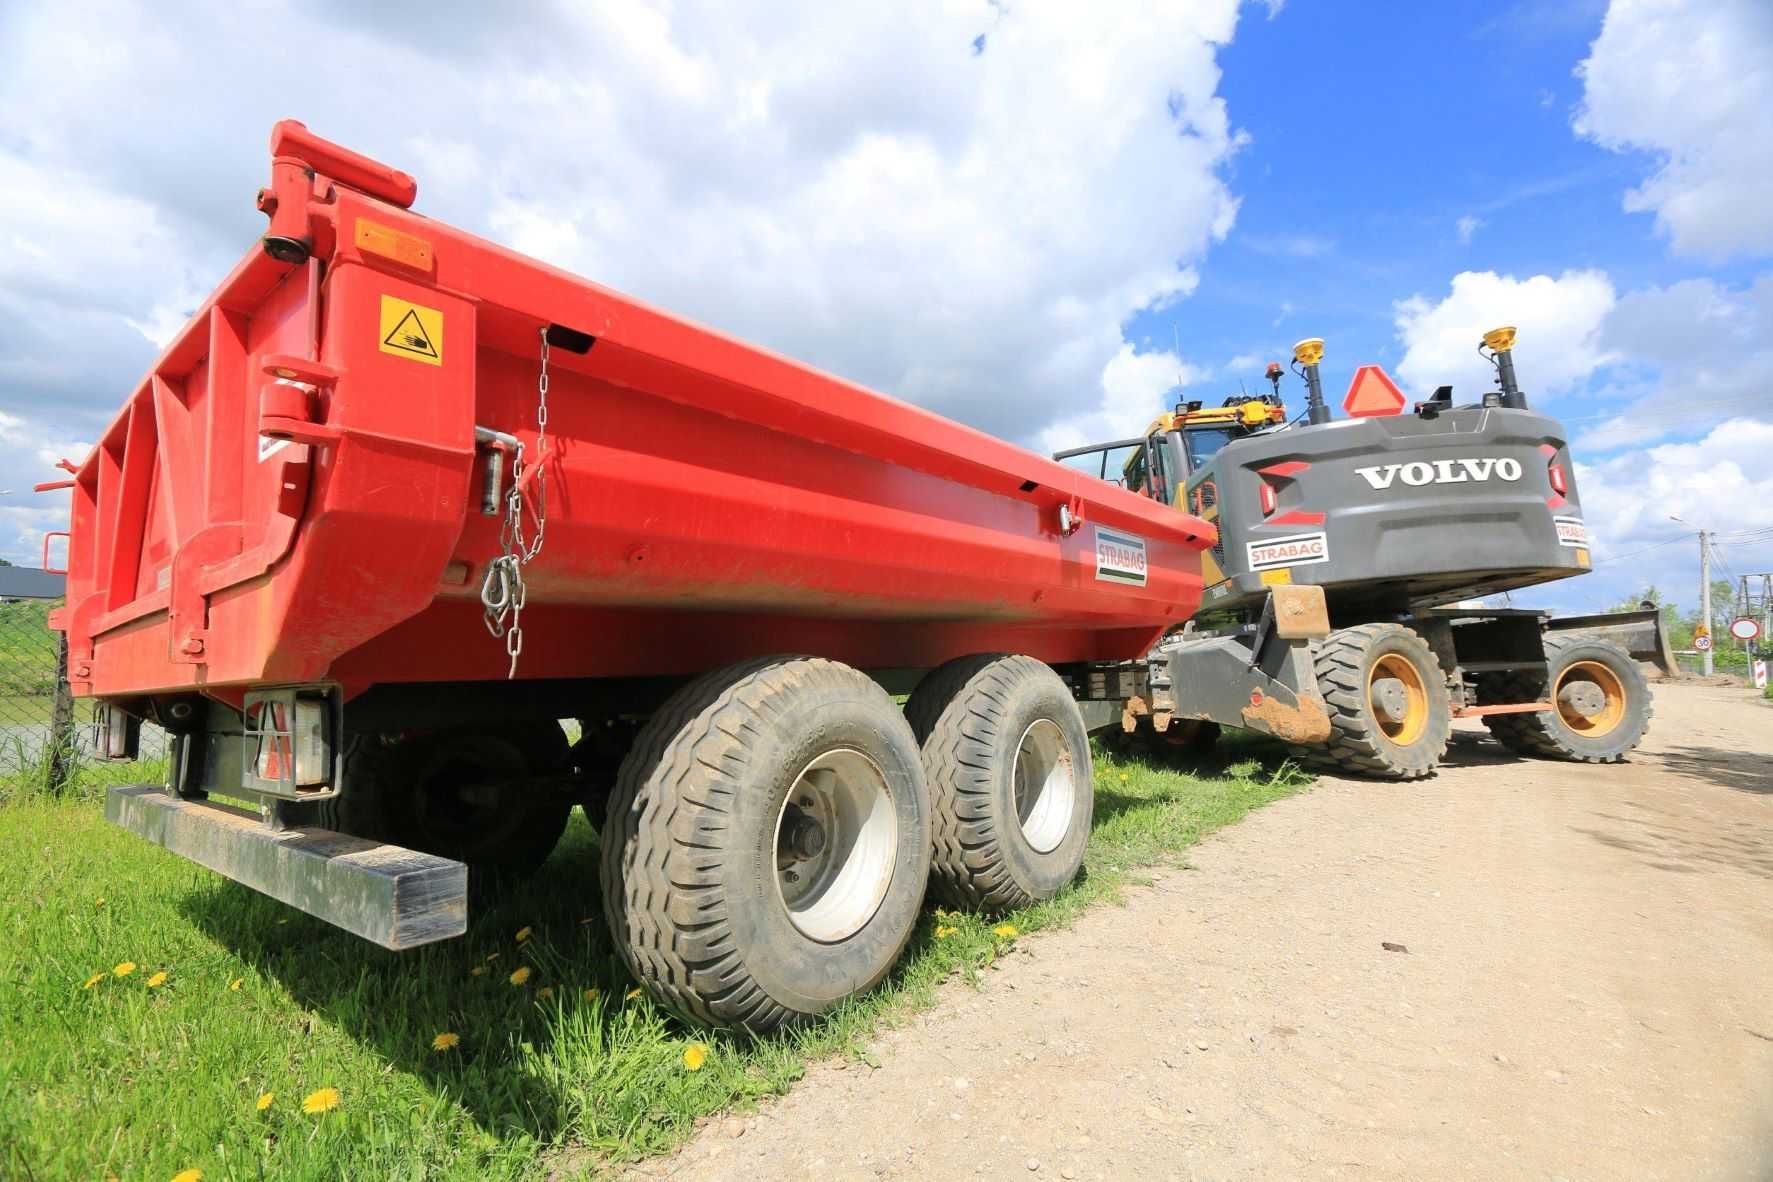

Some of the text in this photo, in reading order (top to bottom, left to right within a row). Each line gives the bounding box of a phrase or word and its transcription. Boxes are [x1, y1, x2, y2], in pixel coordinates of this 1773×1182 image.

[1354, 457, 1522, 490] VOLVO
[1099, 543, 1145, 571] STRABAG
[1251, 542, 1323, 562] STRABAG
